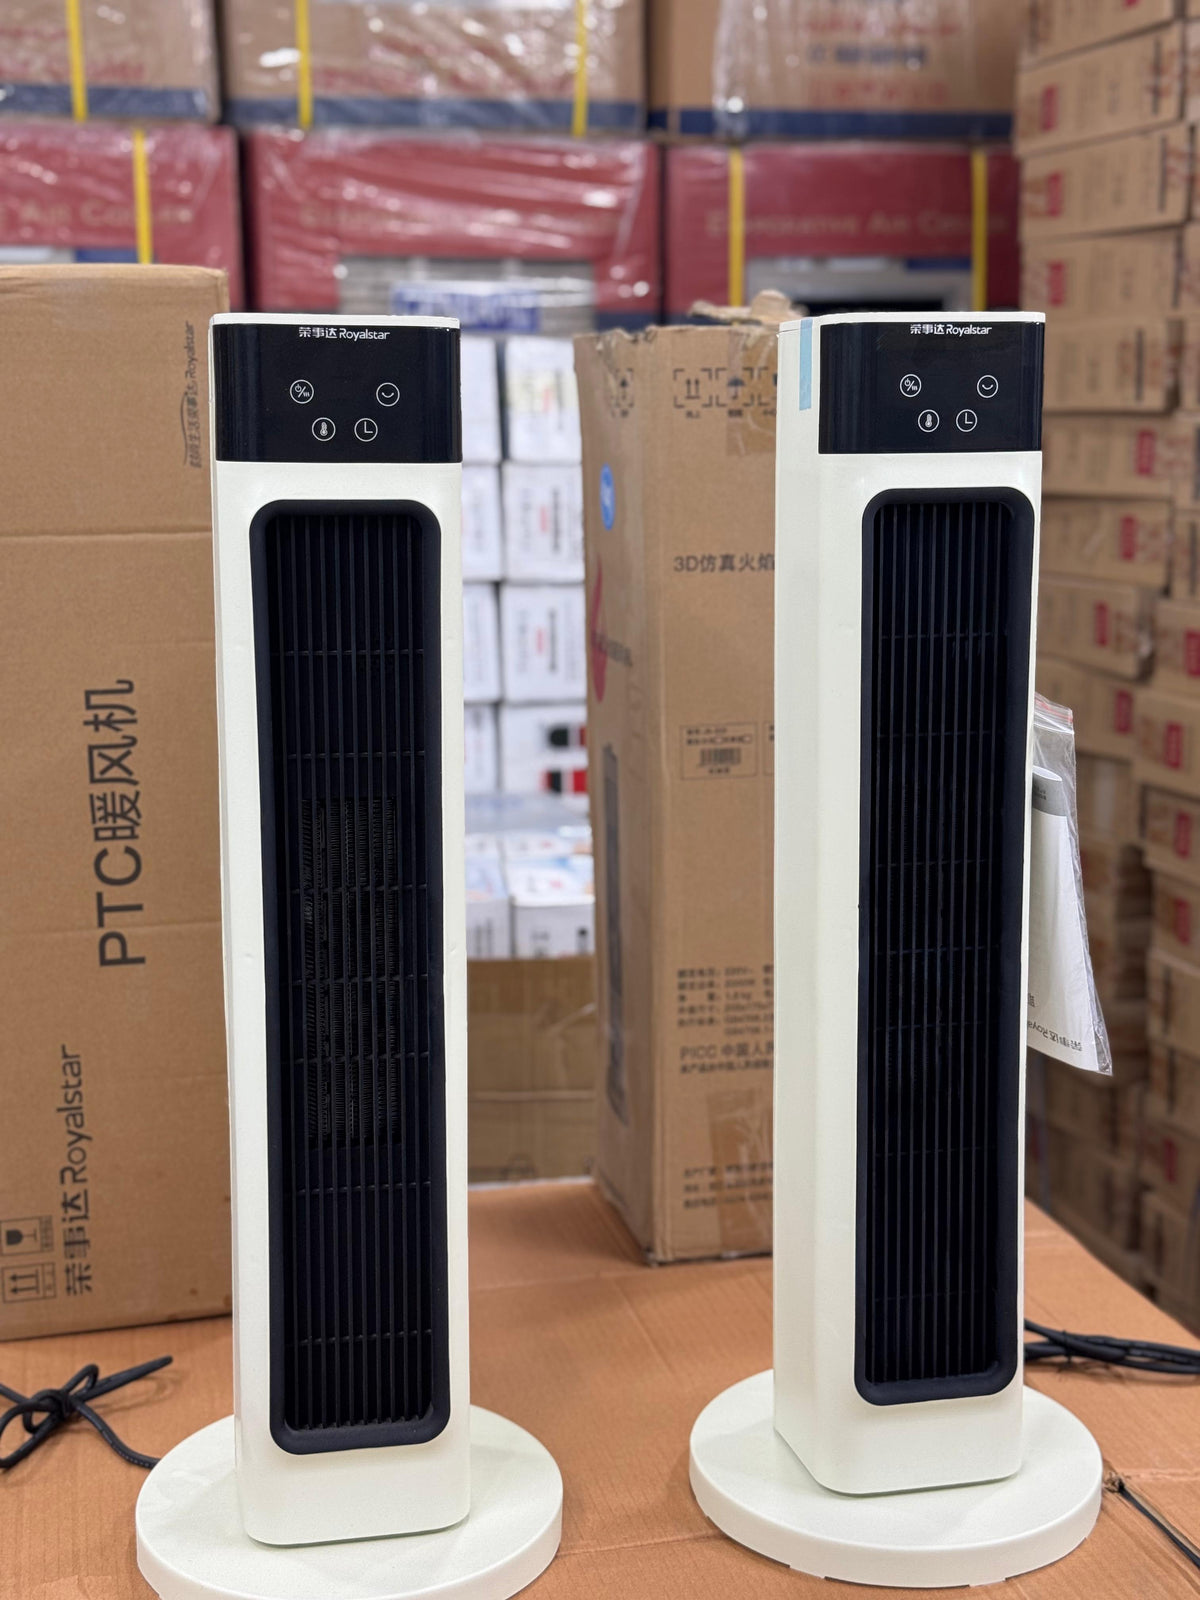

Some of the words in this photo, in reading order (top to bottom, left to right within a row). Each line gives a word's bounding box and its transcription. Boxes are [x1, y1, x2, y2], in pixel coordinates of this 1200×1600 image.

[184, 320, 198, 379] Royalstar
[298, 326, 338, 339] 荣事达
[339, 328, 390, 342] Royalstar
[910, 324, 945, 335] 荣事达
[946, 324, 992, 337] Royalstar
[83, 679, 146, 967] PTC暖风机
[56, 1044, 93, 1185] Royalstar
[61, 1189, 92, 1295] 荣事达
